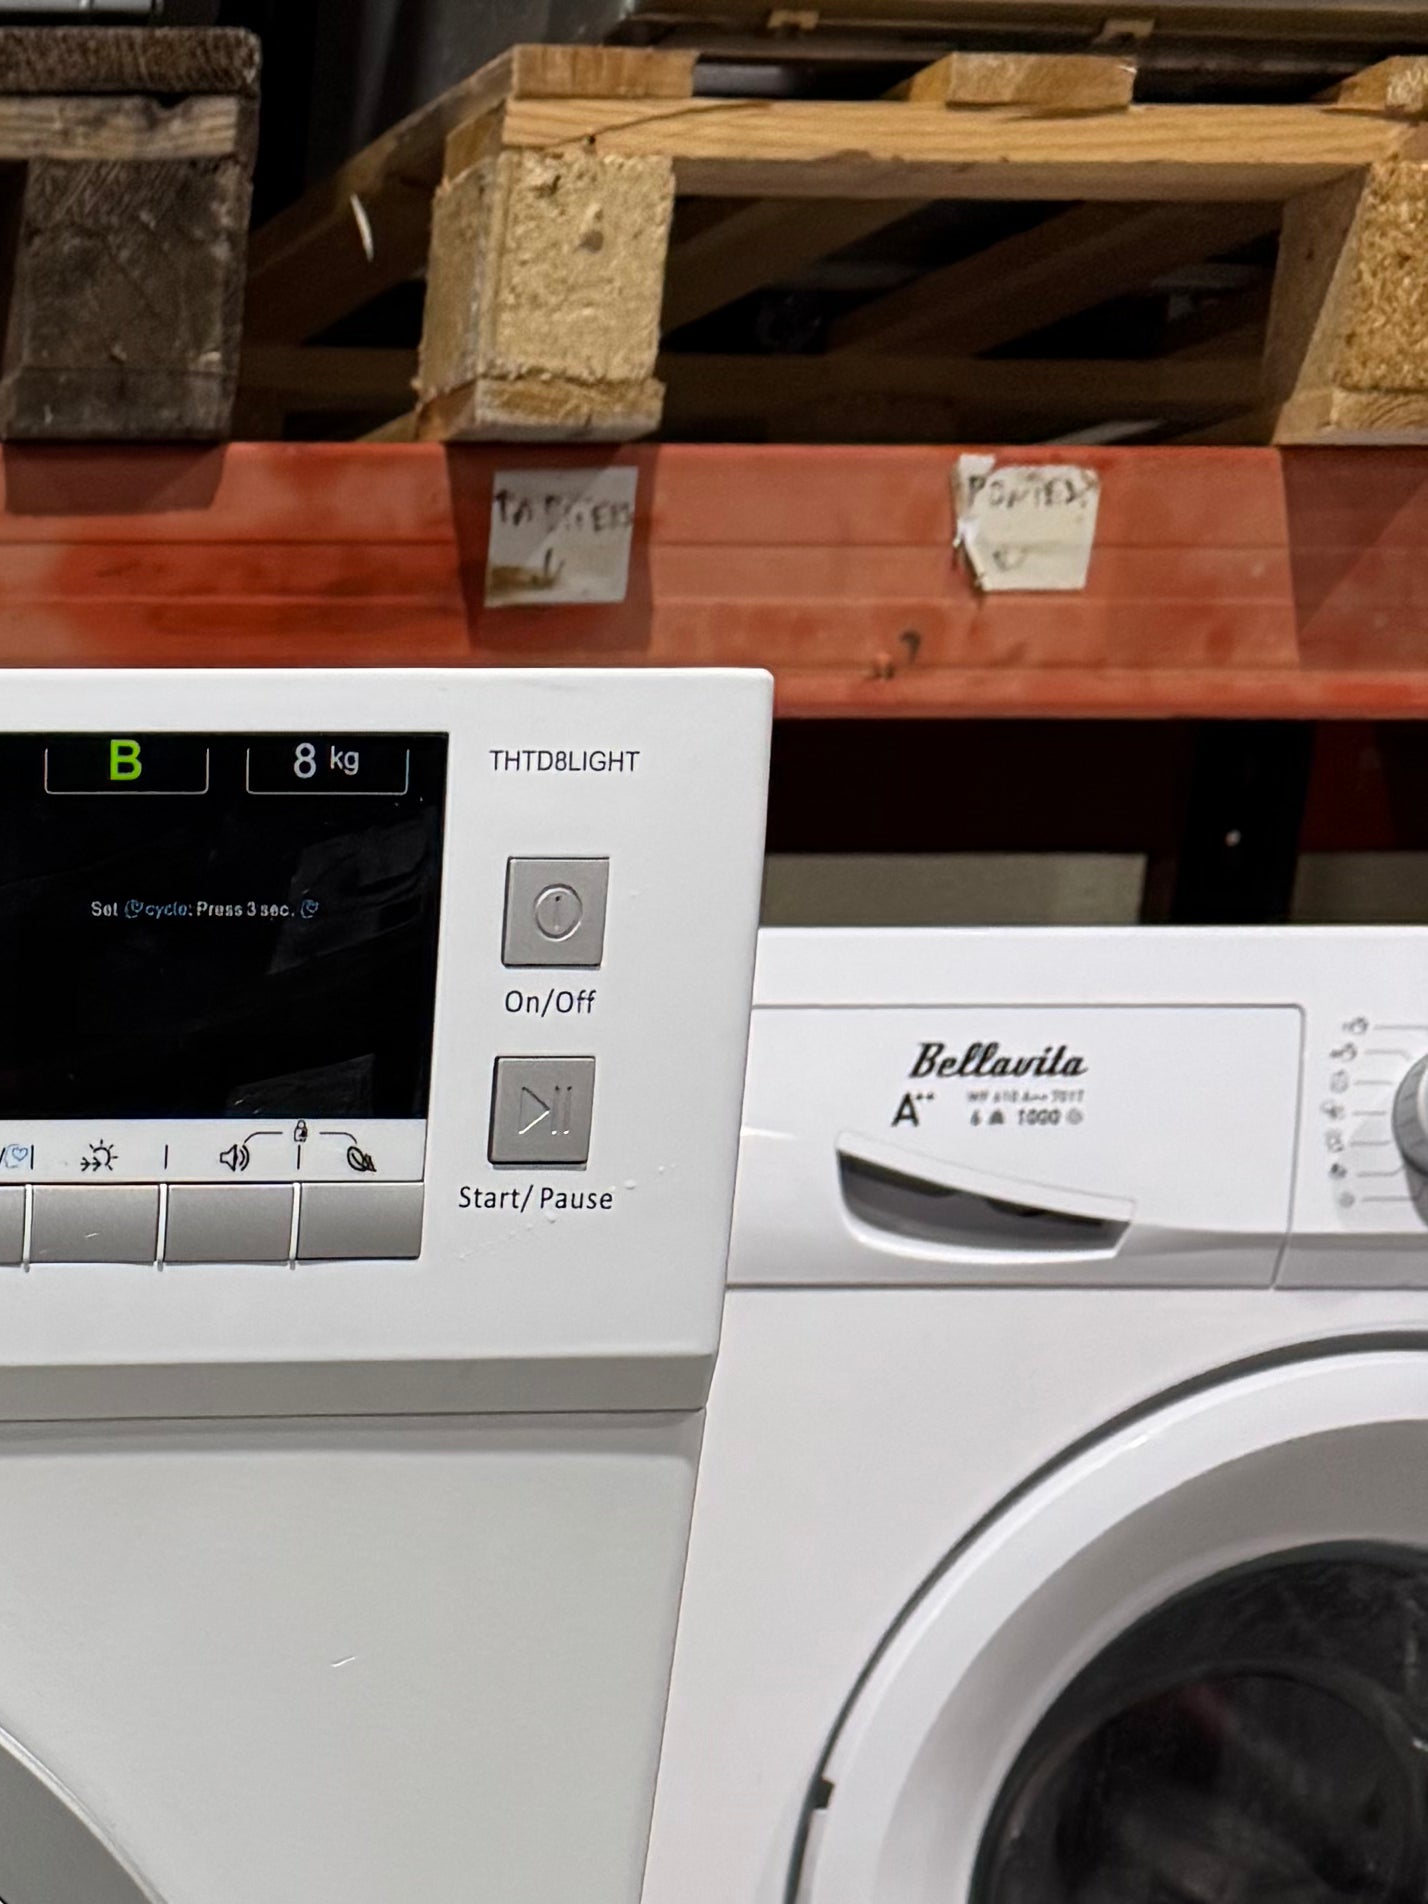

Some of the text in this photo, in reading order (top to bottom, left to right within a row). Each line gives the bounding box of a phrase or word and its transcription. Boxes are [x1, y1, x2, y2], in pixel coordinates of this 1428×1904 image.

[109, 739, 142, 781] B
[293, 742, 360, 779] 8 kg
[489, 749, 641, 773] THTD8LIGHT
[196, 900, 244, 917] Press
[246, 900, 257, 917] 3
[504, 988, 597, 1018] On/Off
[909, 1041, 1088, 1078] Bellavita
[540, 1187, 614, 1210] Pause
